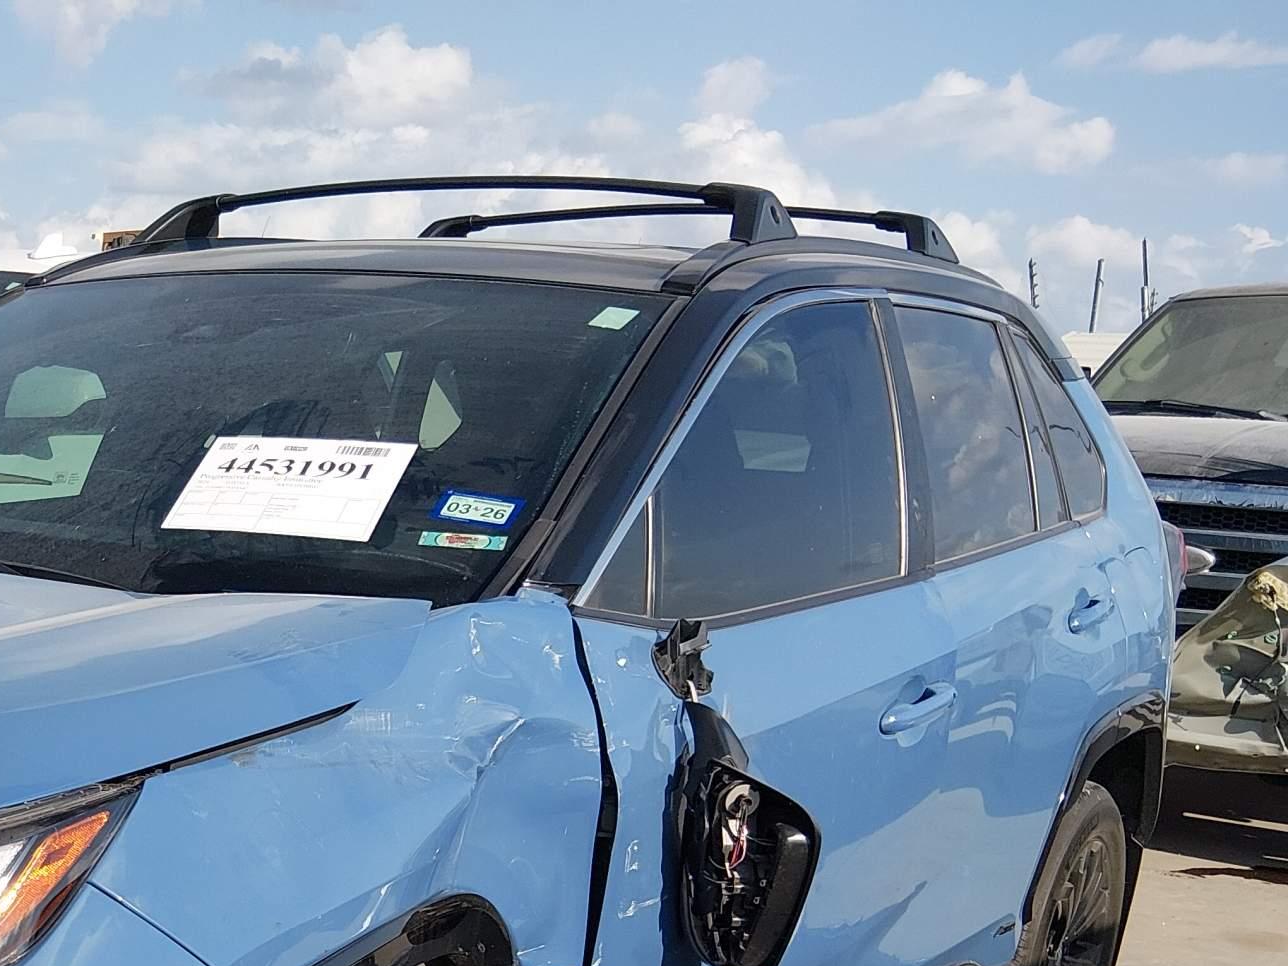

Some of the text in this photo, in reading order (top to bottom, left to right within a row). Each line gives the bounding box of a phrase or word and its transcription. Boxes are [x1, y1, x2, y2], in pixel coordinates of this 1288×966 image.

[217, 457, 374, 480] 44531991
[447, 502, 472, 515] 03
[480, 507, 507, 520] 26
